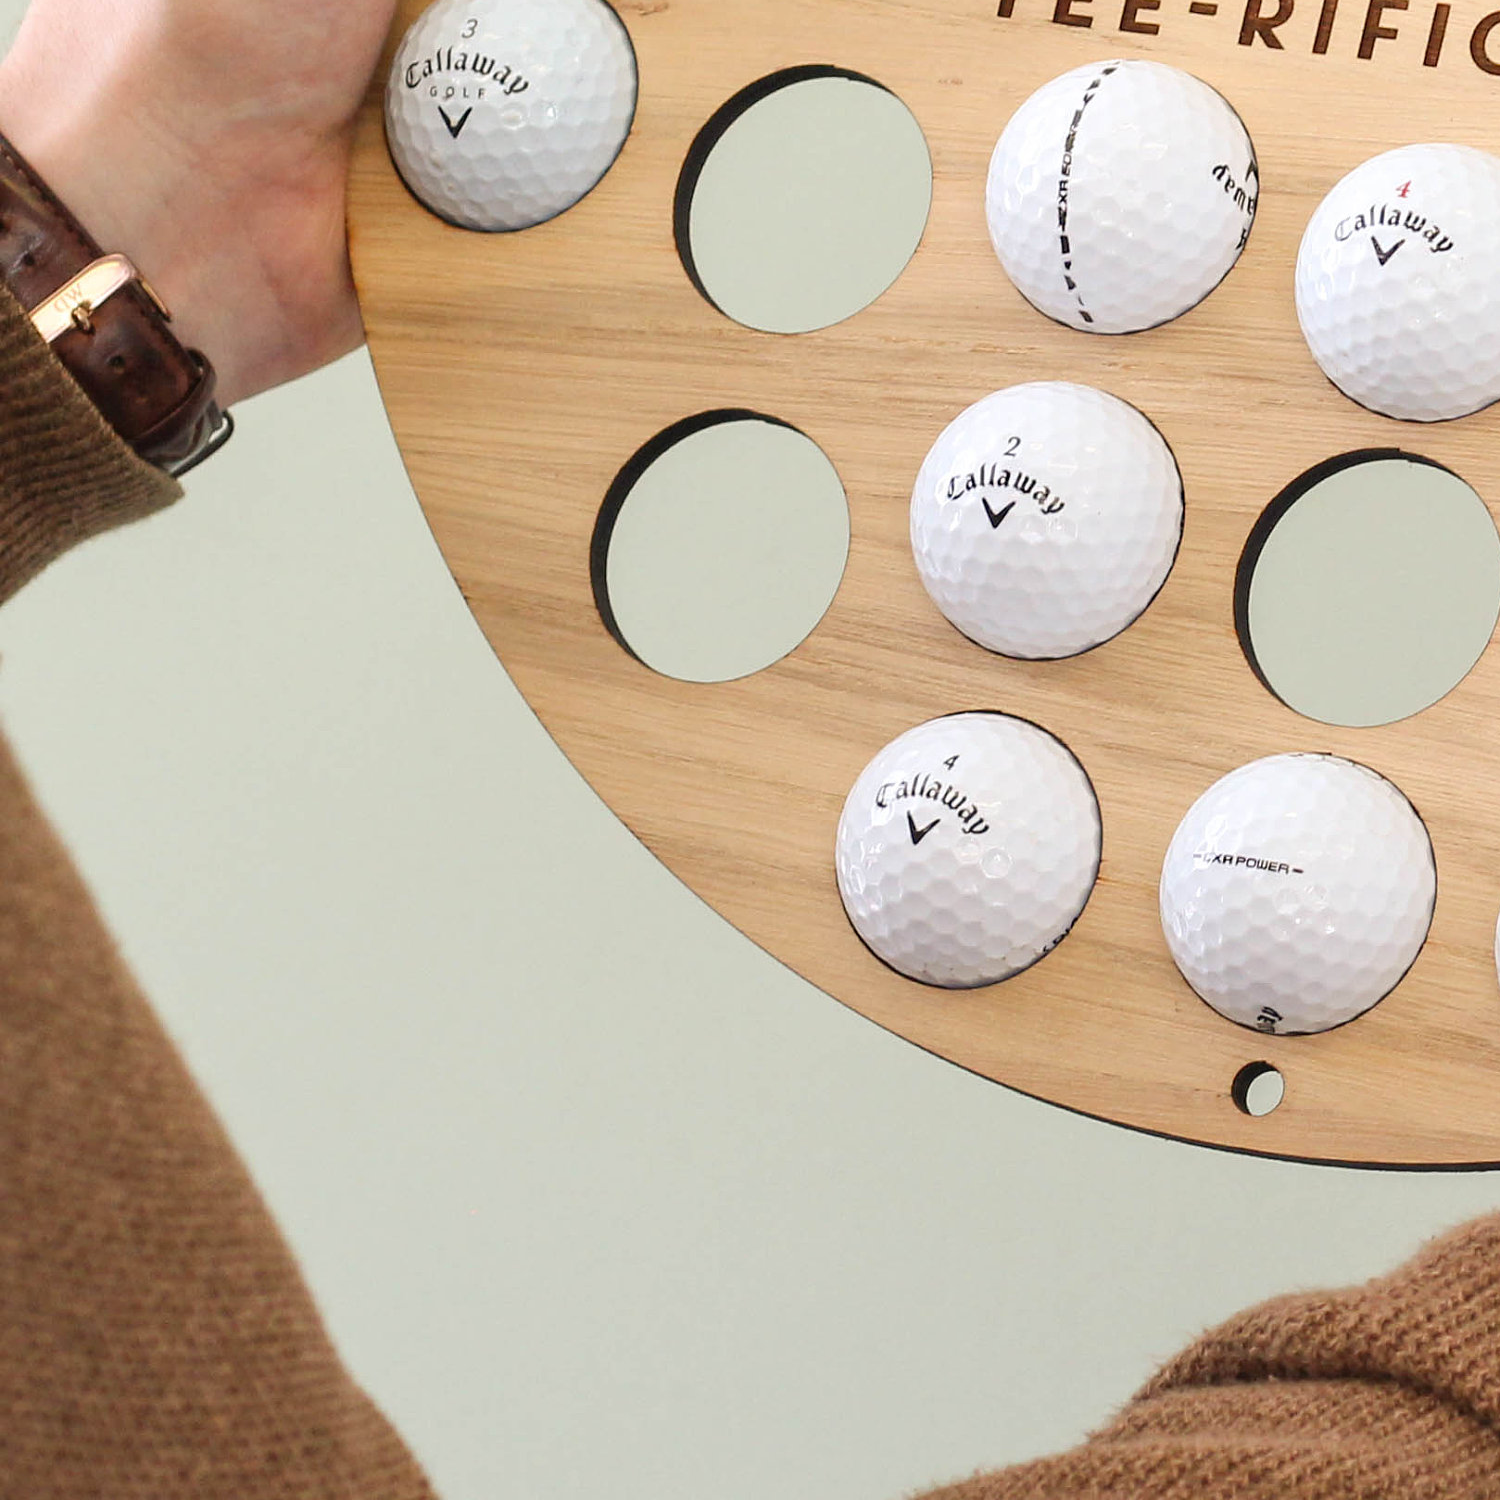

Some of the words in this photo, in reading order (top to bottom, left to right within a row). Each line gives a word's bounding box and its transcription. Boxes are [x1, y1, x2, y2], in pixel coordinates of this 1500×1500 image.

[460, 17, 479, 40] 3
[404, 44, 530, 96] Callaway
[428, 84, 488, 100] GOLF
[1395, 179, 1412, 199] 4
[1334, 203, 1455, 257] Callaway
[1002, 435, 1022, 458] 2
[946, 462, 1066, 518] Callaway
[942, 754, 961, 772] 4
[875, 773, 991, 838] Callaway
[1235, 855, 1290, 875] POWER
